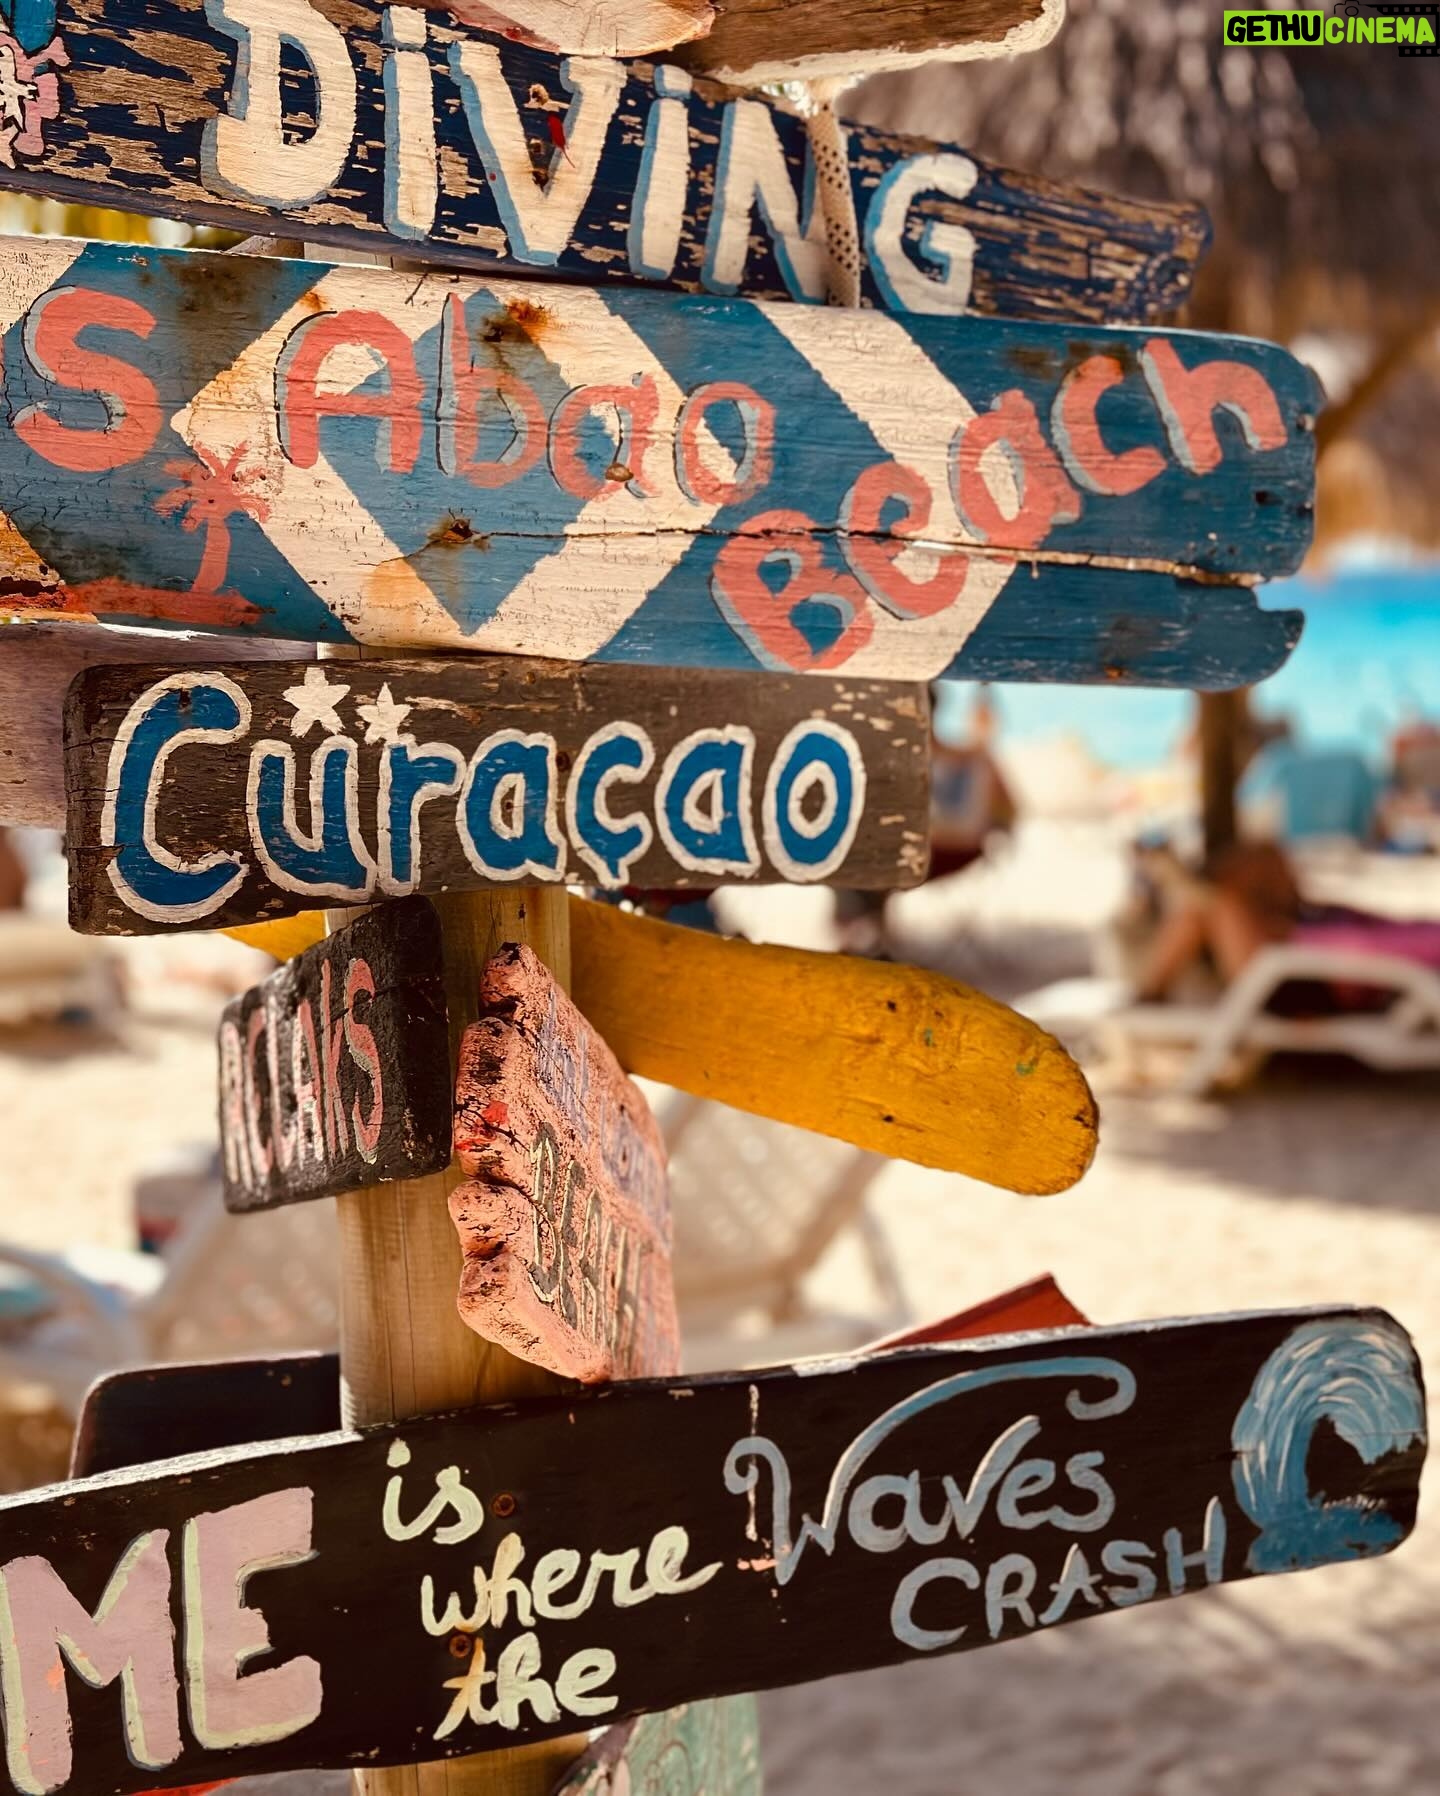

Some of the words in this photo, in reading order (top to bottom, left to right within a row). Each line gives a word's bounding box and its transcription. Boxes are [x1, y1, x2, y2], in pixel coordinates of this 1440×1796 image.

[0, 285, 164, 472] S
[274, 292, 775, 508] Abao
[711, 338, 1288, 673] Beach
[100, 671, 867, 924] Curaçao
[382, 1439, 485, 1544] is
[723, 1356, 1137, 1585] Waves
[0, 1486, 323, 1796] ME
[421, 1525, 723, 1637] where
[891, 1496, 1227, 1651] CRASH
[433, 1631, 619, 1741] the
